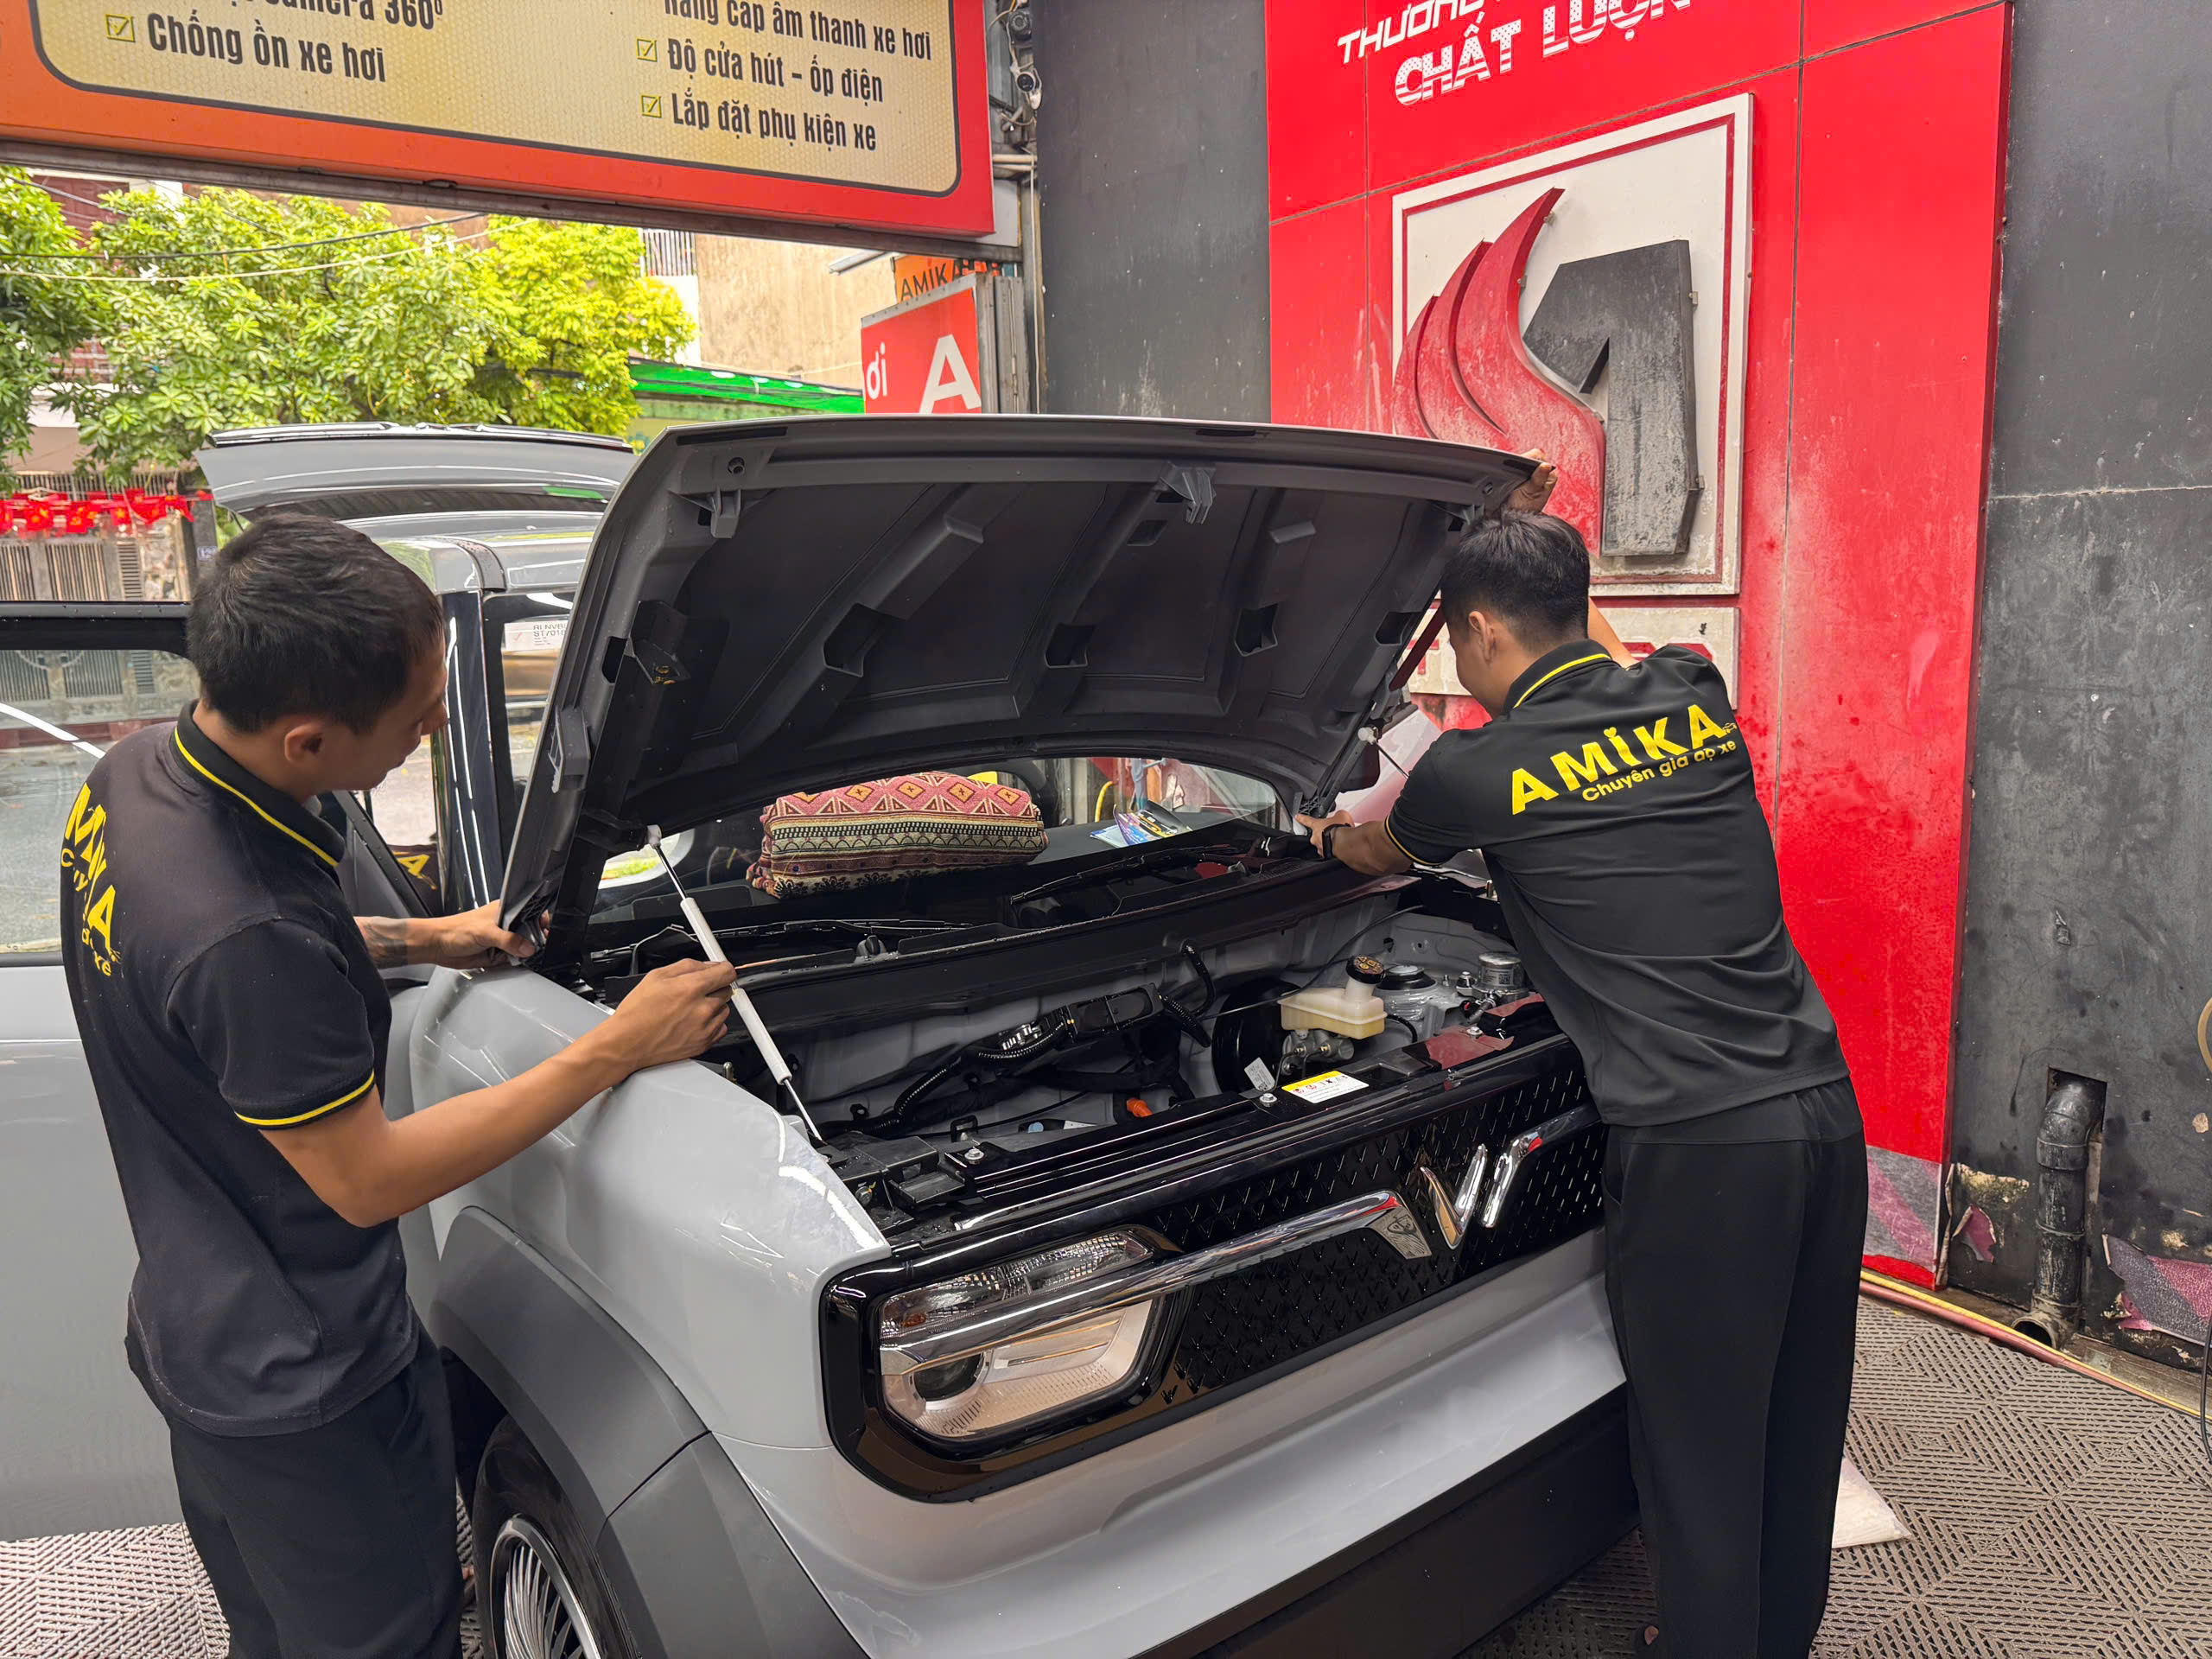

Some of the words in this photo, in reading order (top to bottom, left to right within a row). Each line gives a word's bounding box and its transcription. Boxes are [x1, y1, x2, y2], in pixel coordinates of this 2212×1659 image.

[148, 10, 243, 65] Chống
[253, 19, 289, 69] ồn
[298, 39, 333, 75] xe
[342, 41, 386, 82] hơi
[772, 1, 804, 38] âm
[810, 10, 867, 49] thanh
[874, 26, 896, 54] xe
[903, 28, 931, 60] hơi
[1395, 11, 1522, 105] CHẤT
[667, 38, 696, 79] Độ
[703, 41, 743, 80] cửa
[751, 53, 785, 87] hút
[810, 54, 834, 96] ốp
[842, 68, 883, 105] điện
[671, 87, 710, 130] Lắp
[717, 100, 752, 140] đặt
[759, 110, 796, 147] phụ
[804, 112, 848, 151] kiện
[854, 124, 876, 151] xe
[918, 334, 982, 413] A
[1582, 768, 1656, 802] Chuyên
[1659, 757, 1688, 778] gia
[1717, 741, 1737, 755] xe
